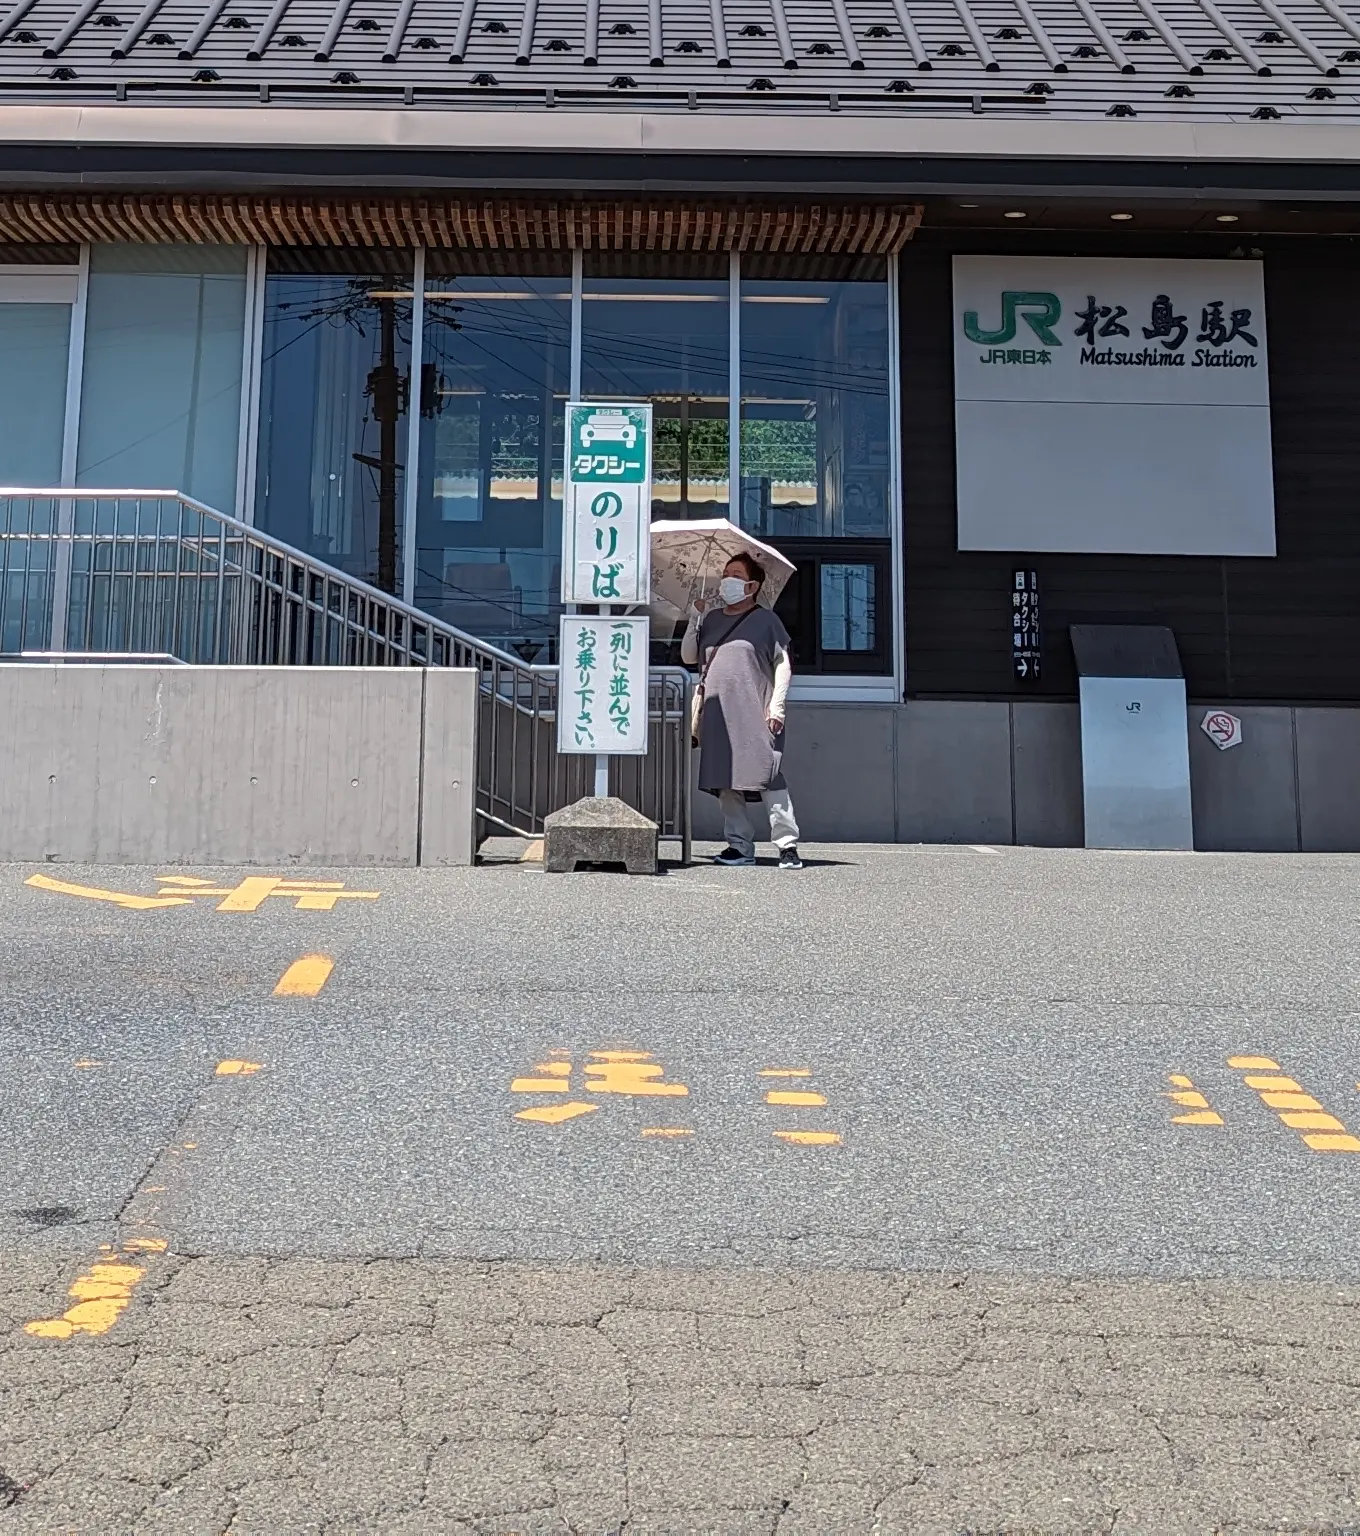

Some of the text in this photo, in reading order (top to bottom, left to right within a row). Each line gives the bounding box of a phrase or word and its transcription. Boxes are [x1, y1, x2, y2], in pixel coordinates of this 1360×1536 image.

[964, 291, 1062, 346] JR
[1074, 295, 1259, 350] 松島駅
[979, 349, 1052, 365] JR東日本
[1080, 347, 1258, 368] Matsushima Station
[575, 454, 640, 475] タクシー
[590, 491, 625, 598] のりば
[608, 622, 633, 736] 一列に並んで
[1125, 702, 1141, 711] JR
